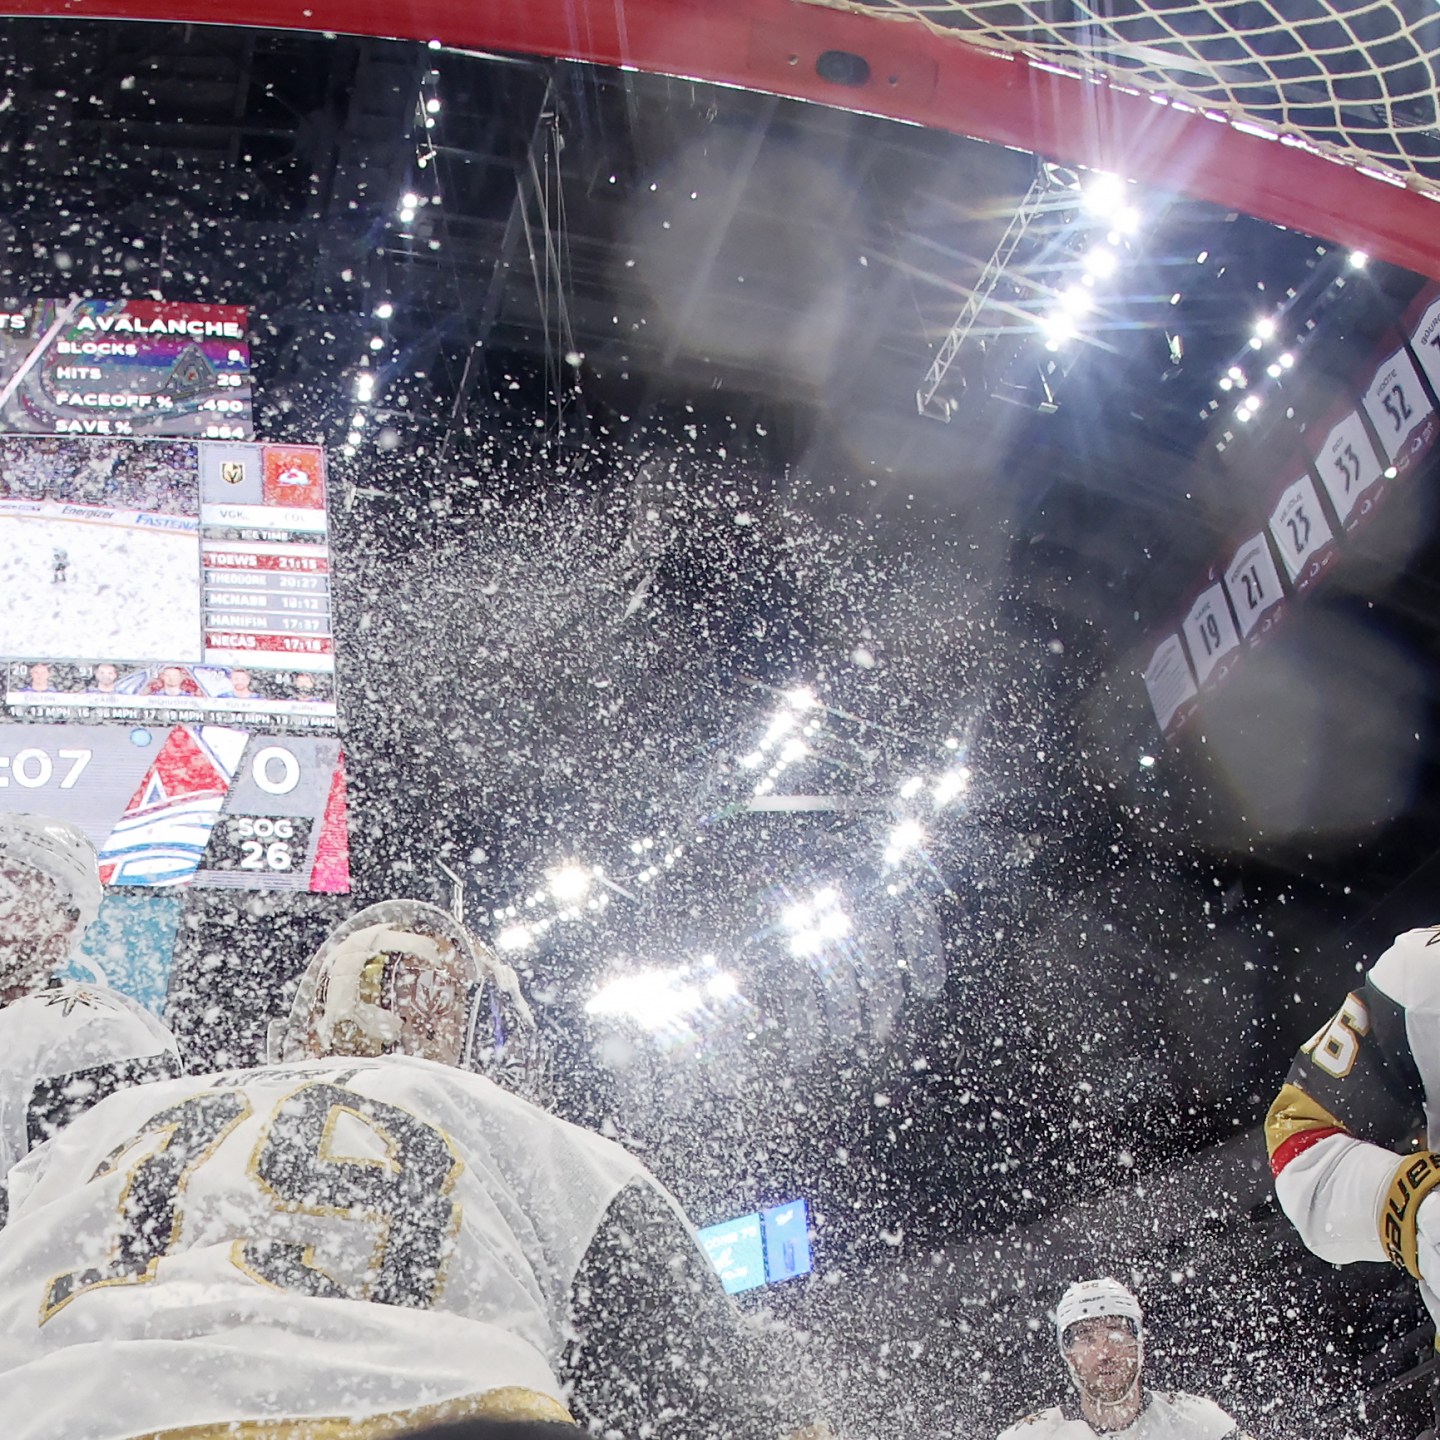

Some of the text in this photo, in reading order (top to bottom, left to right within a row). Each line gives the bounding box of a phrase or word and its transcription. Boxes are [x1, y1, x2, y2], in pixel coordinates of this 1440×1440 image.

[77, 316, 240, 336] AVALANCHE
[56, 342, 138, 355] BLOCKS
[56, 367, 242, 387] HITS 26
[55, 393, 243, 412] FACEOFF % .490
[1381, 383, 1412, 432] 52
[55, 419, 110, 434] SAVE
[114, 420, 133, 434] %
[1334, 443, 1360, 494] 33
[61, 505, 116, 519] Energizer
[208, 553, 258, 566] TOEWS
[1241, 565, 1264, 610] 21
[209, 634, 257, 647] NECAS
[1199, 613, 1221, 656] 19
[45, 707, 71, 716] MPH
[112, 708, 137, 718] MPH
[178, 711, 204, 721] MPH
[244, 713, 271, 724] MPH
[310, 716, 336, 727] MPH
[252, 746, 301, 794] 0
[239, 817, 293, 838] SOG
[241, 841, 292, 870] 26
